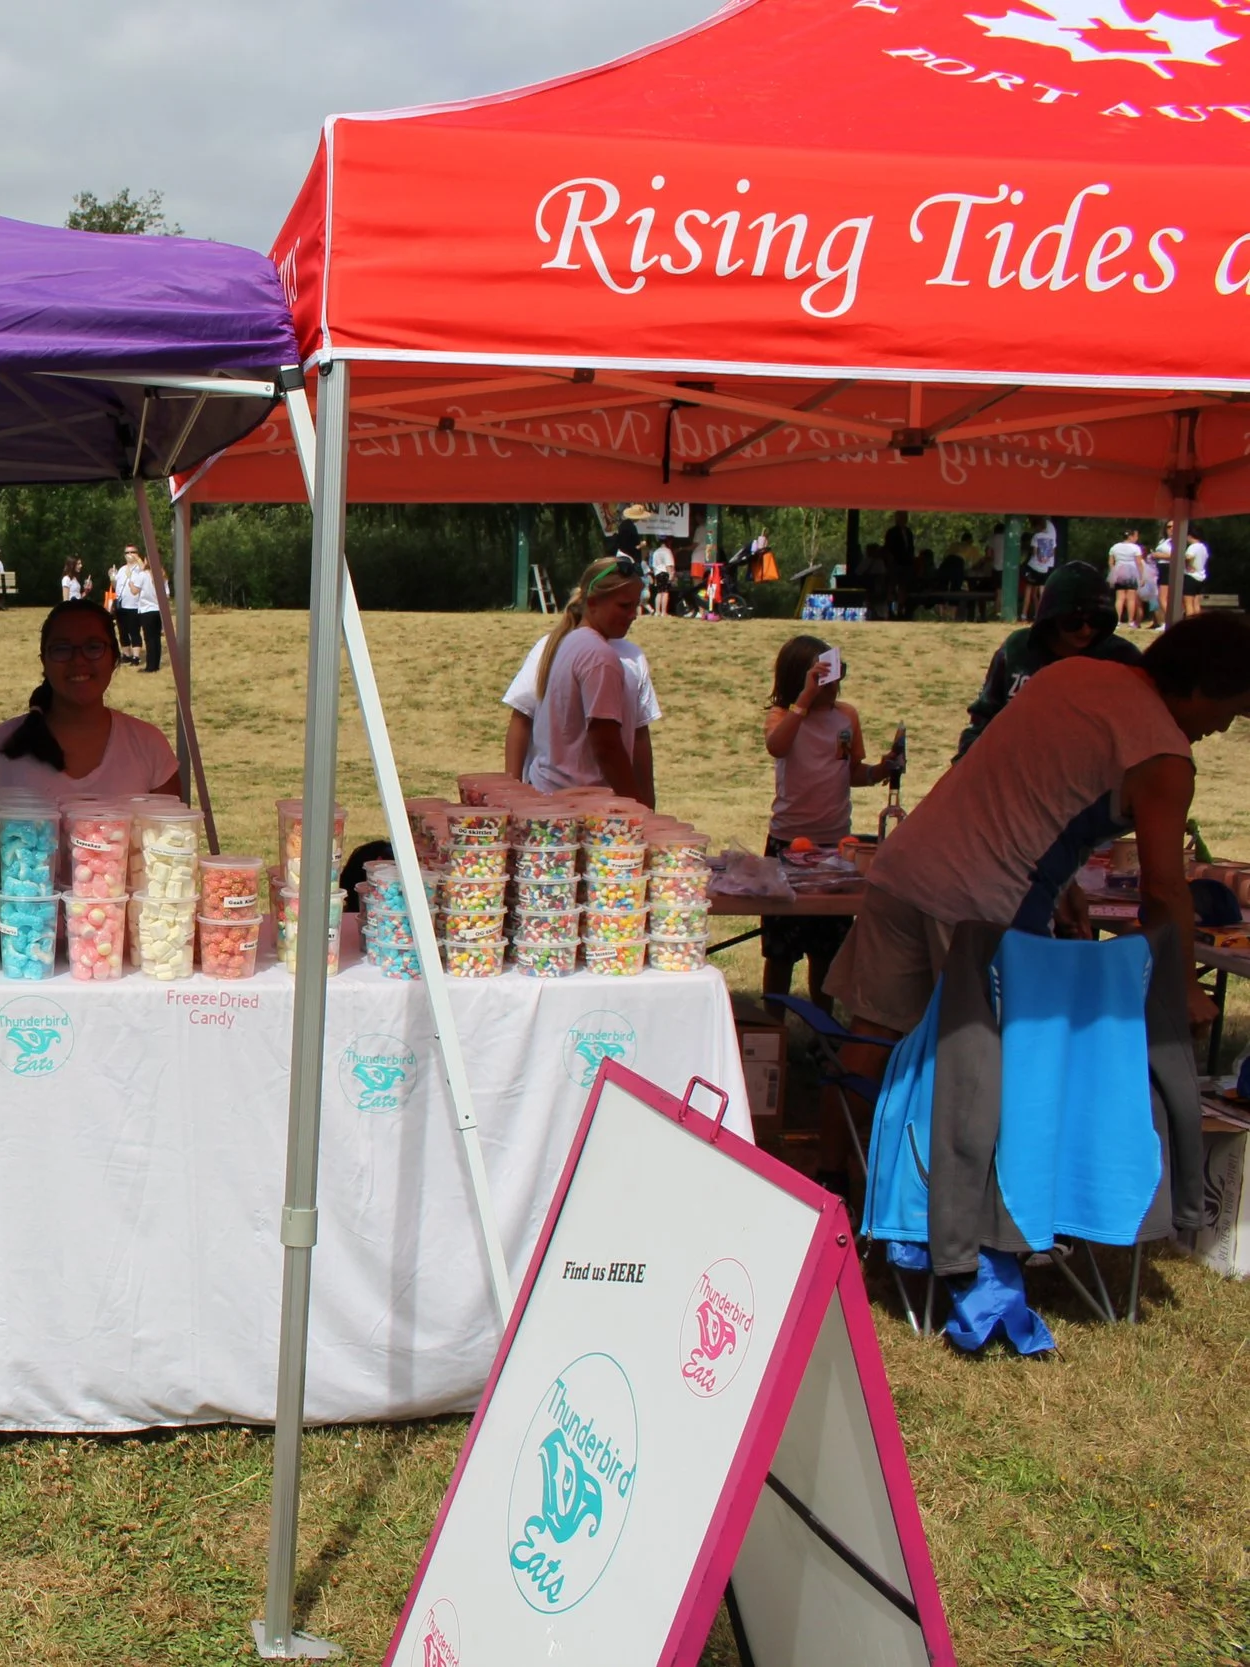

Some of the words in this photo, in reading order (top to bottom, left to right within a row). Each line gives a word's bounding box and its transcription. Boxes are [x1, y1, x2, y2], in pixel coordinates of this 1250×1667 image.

[881, 47, 1078, 104] PORT
[535, 175, 874, 318] Rising
[909, 183, 1185, 295] Tides
[166, 989, 217, 1006] Freeze
[219, 991, 259, 1008] Dried
[189, 1009, 235, 1029] Candy
[568, 1028, 635, 1042] Thunderbird
[13, 1052, 53, 1075] Eats
[344, 1048, 415, 1065] Thunderbird
[357, 1089, 399, 1110] Eats
[562, 1260, 590, 1281] Find
[591, 1264, 606, 1281] us
[607, 1262, 646, 1284] HERE
[699, 1272, 754, 1333] Thunderbird
[682, 1348, 717, 1393] Eats
[548, 1377, 637, 1499] Thunderbird
[510, 1515, 565, 1604] Eats
